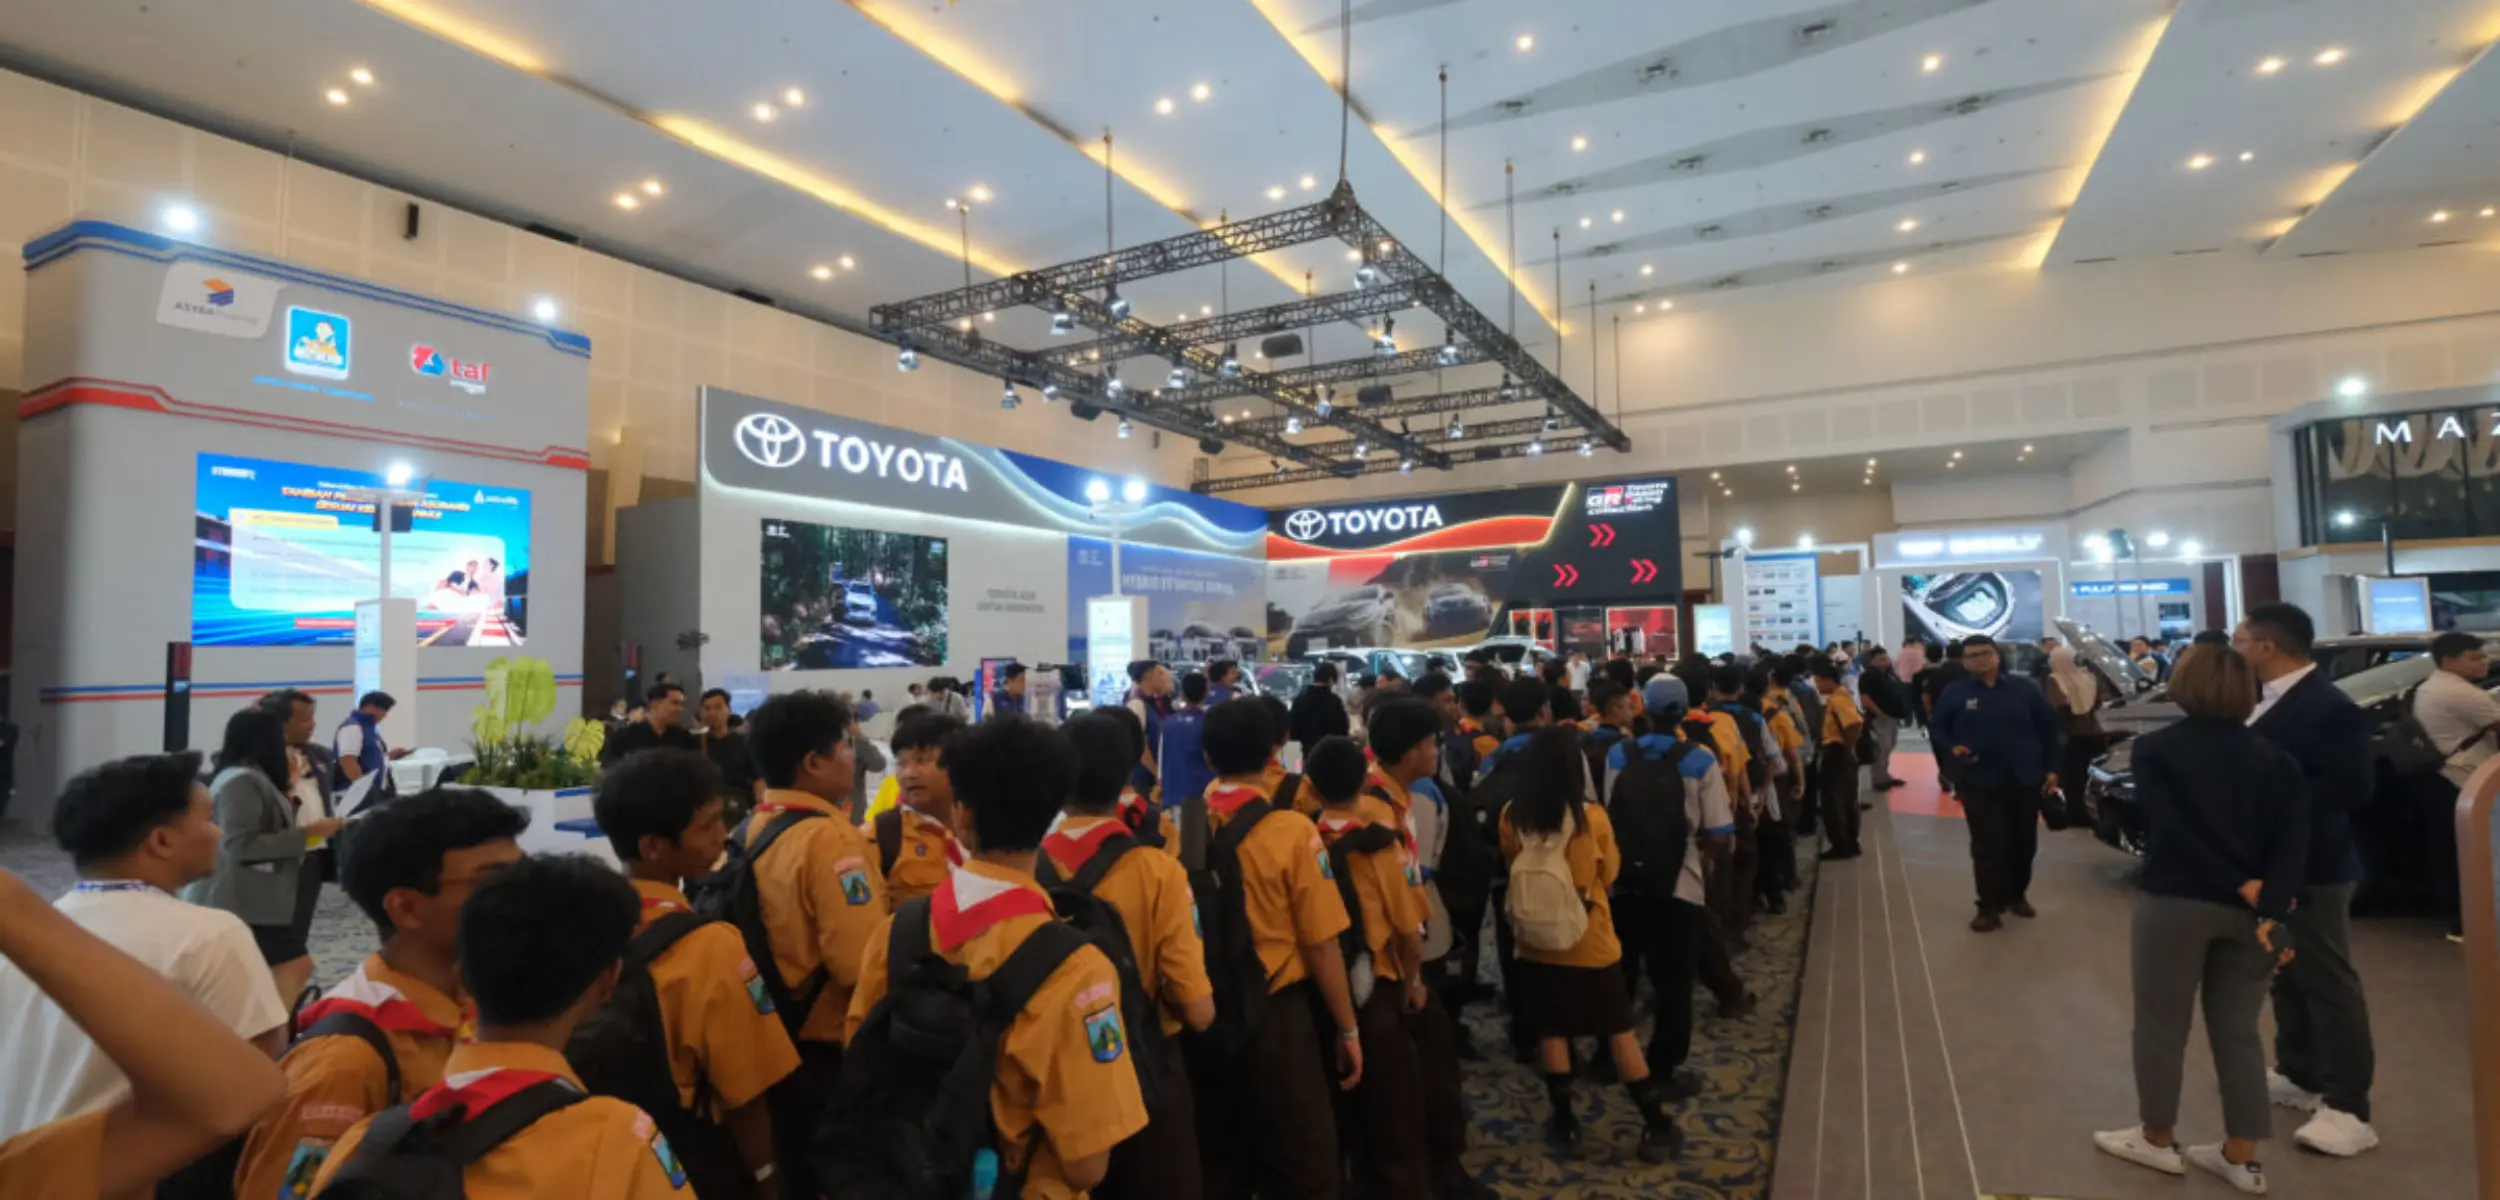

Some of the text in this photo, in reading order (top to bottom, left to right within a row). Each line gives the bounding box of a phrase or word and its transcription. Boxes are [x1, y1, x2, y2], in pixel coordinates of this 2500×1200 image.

[452, 358, 492, 382] taf
[811, 429, 969, 492] TOYOTA
[1328, 503, 1443, 535] TOYOTA
